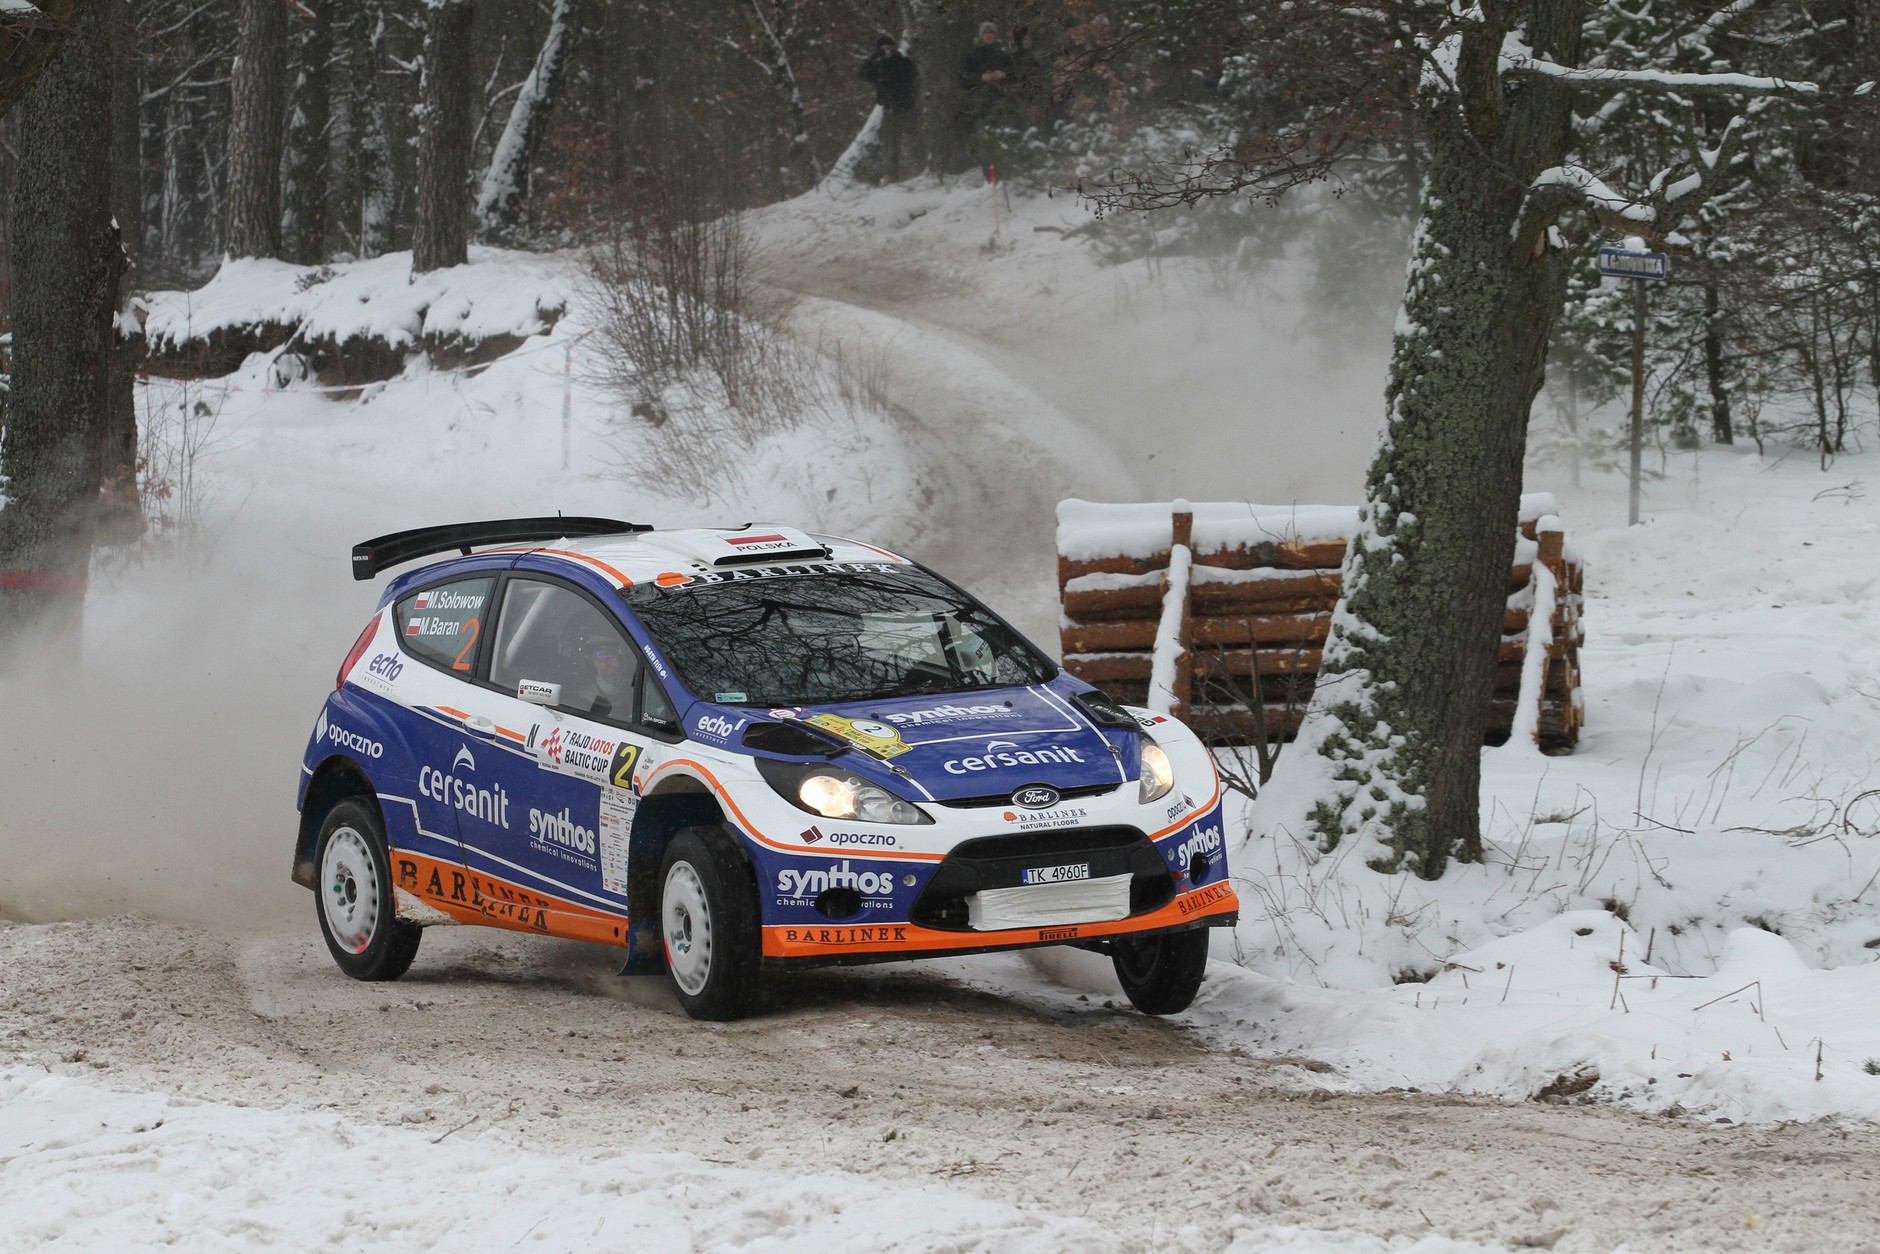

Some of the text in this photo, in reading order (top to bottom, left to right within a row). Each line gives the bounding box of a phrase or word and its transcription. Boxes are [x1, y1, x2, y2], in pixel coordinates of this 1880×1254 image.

[736, 540, 798, 553] POLSKA
[704, 562, 900, 584] BARLINEK
[419, 617, 459, 636] M.Baran
[452, 617, 480, 671] 2
[369, 652, 404, 681] echo
[520, 684, 553, 695] GETCAR
[884, 703, 1012, 724] synthos
[900, 712, 1022, 730] chemical innovations
[526, 723, 540, 749] N
[698, 715, 733, 737] echo
[863, 725, 882, 733] 2
[328, 723, 384, 759] opoczno
[562, 730, 616, 756] 7 RAJD LOTOS
[693, 730, 727, 745] INVESTMENT
[564, 749, 592, 770] BALTIC
[592, 756, 609, 774] CUP
[614, 745, 638, 789] 2
[943, 744, 1086, 775] cersanit
[418, 765, 510, 830] cersanit
[1024, 790, 1050, 803] Ford
[1020, 807, 1087, 822] BARLINEK
[1020, 818, 1080, 830] NATURAL FLOORS
[529, 807, 596, 855] synthos
[829, 832, 896, 846] opoczno
[529, 841, 559, 857] chemical
[560, 851, 598, 873] innovations
[1177, 822, 1221, 870] synthos
[776, 859, 895, 899] synthos
[1028, 864, 1087, 883] TK 4960F
[776, 897, 816, 908] chemic
[1178, 884, 1232, 914] BARLINEK
[786, 927, 907, 943] BARLINEK
[1039, 927, 1078, 941] PIRELLI
